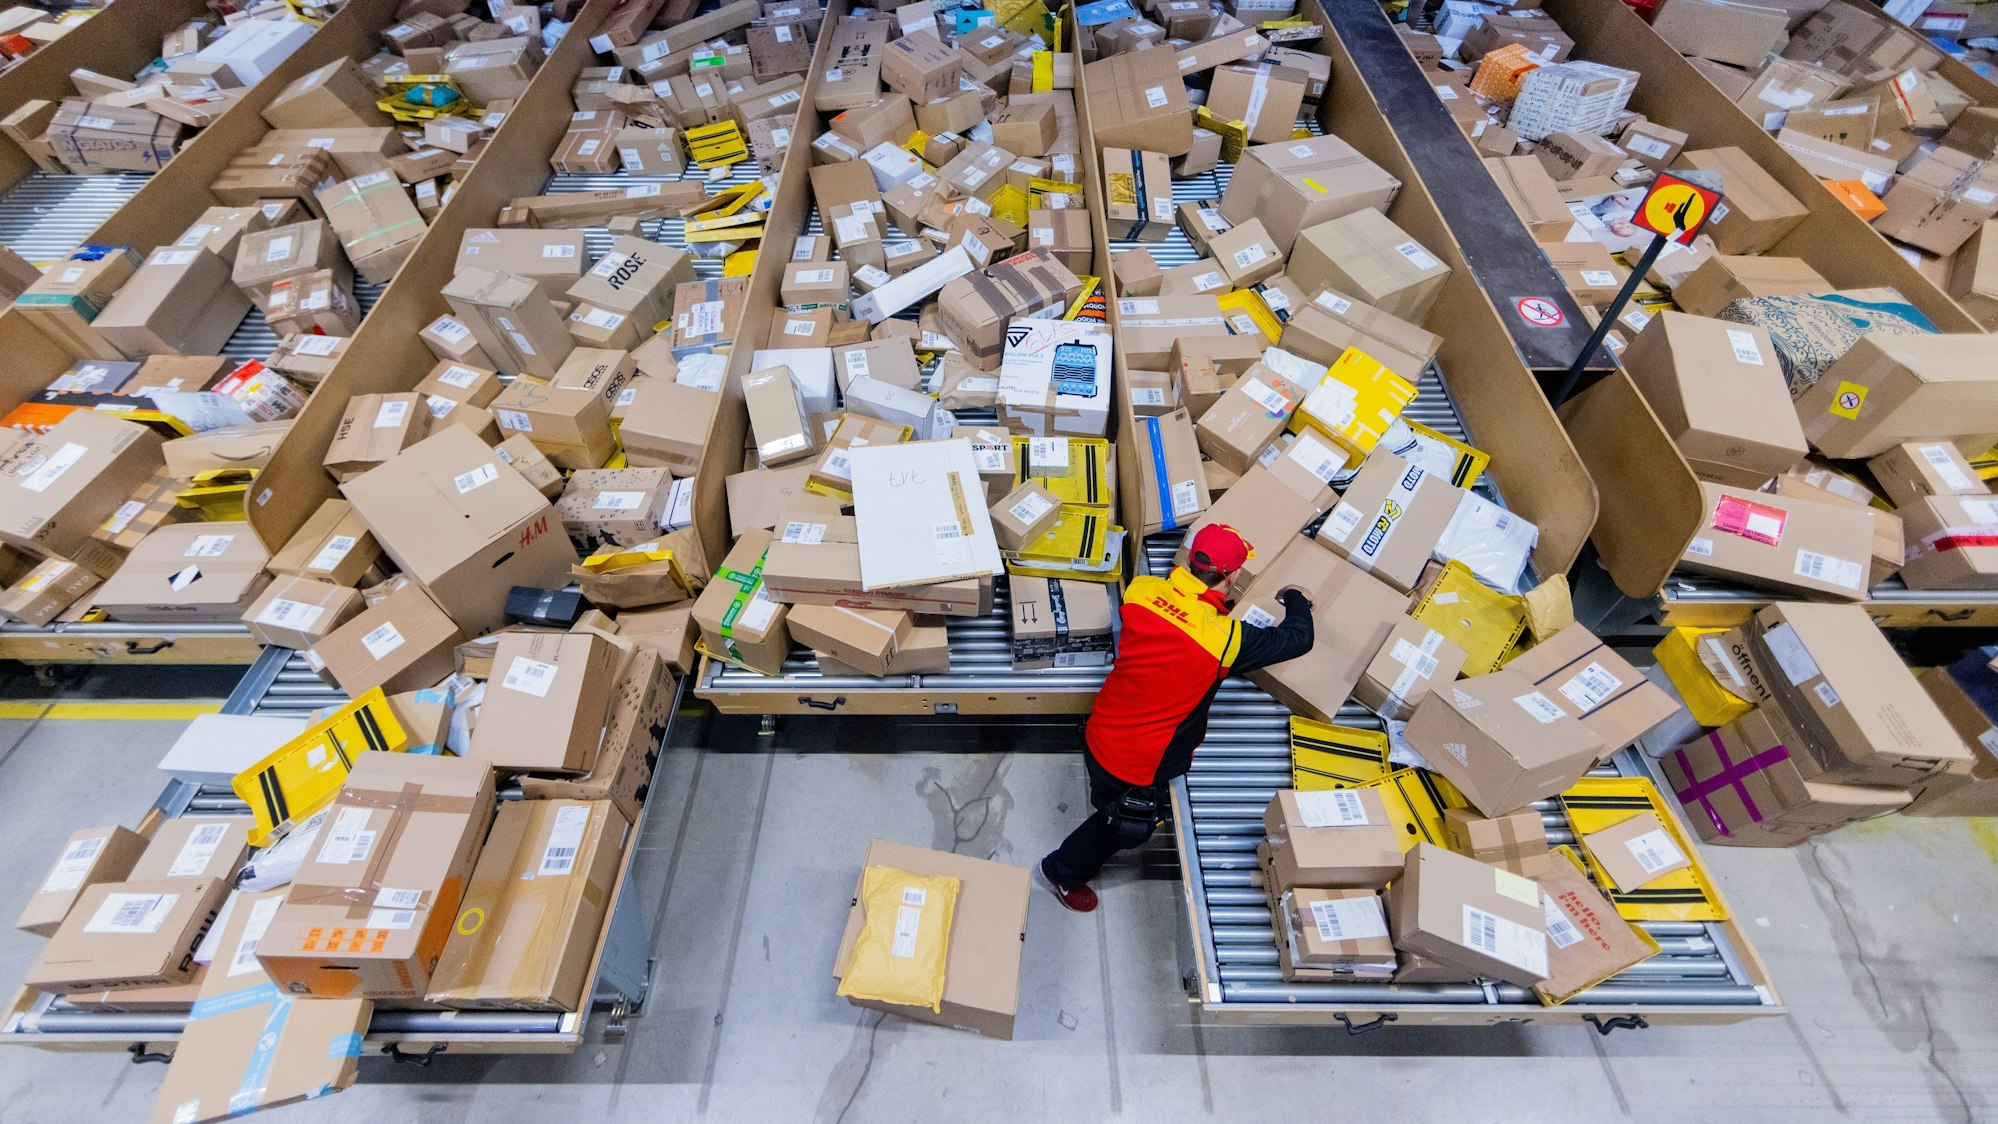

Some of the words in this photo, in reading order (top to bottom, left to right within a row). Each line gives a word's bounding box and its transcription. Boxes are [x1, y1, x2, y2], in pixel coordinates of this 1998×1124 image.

[608, 252, 646, 290] ROSE
[337, 417, 355, 440] HSE
[519, 516, 548, 549] H&M
[1361, 526, 1385, 556] MOTO
[1377, 516, 1391, 533] FC
[1152, 596, 1189, 624] DHL
[1732, 643, 1771, 702] Öffnen!
[1558, 894, 1580, 917] i'm
[1580, 917, 1610, 950] here
[1567, 890, 1601, 930] hello,
